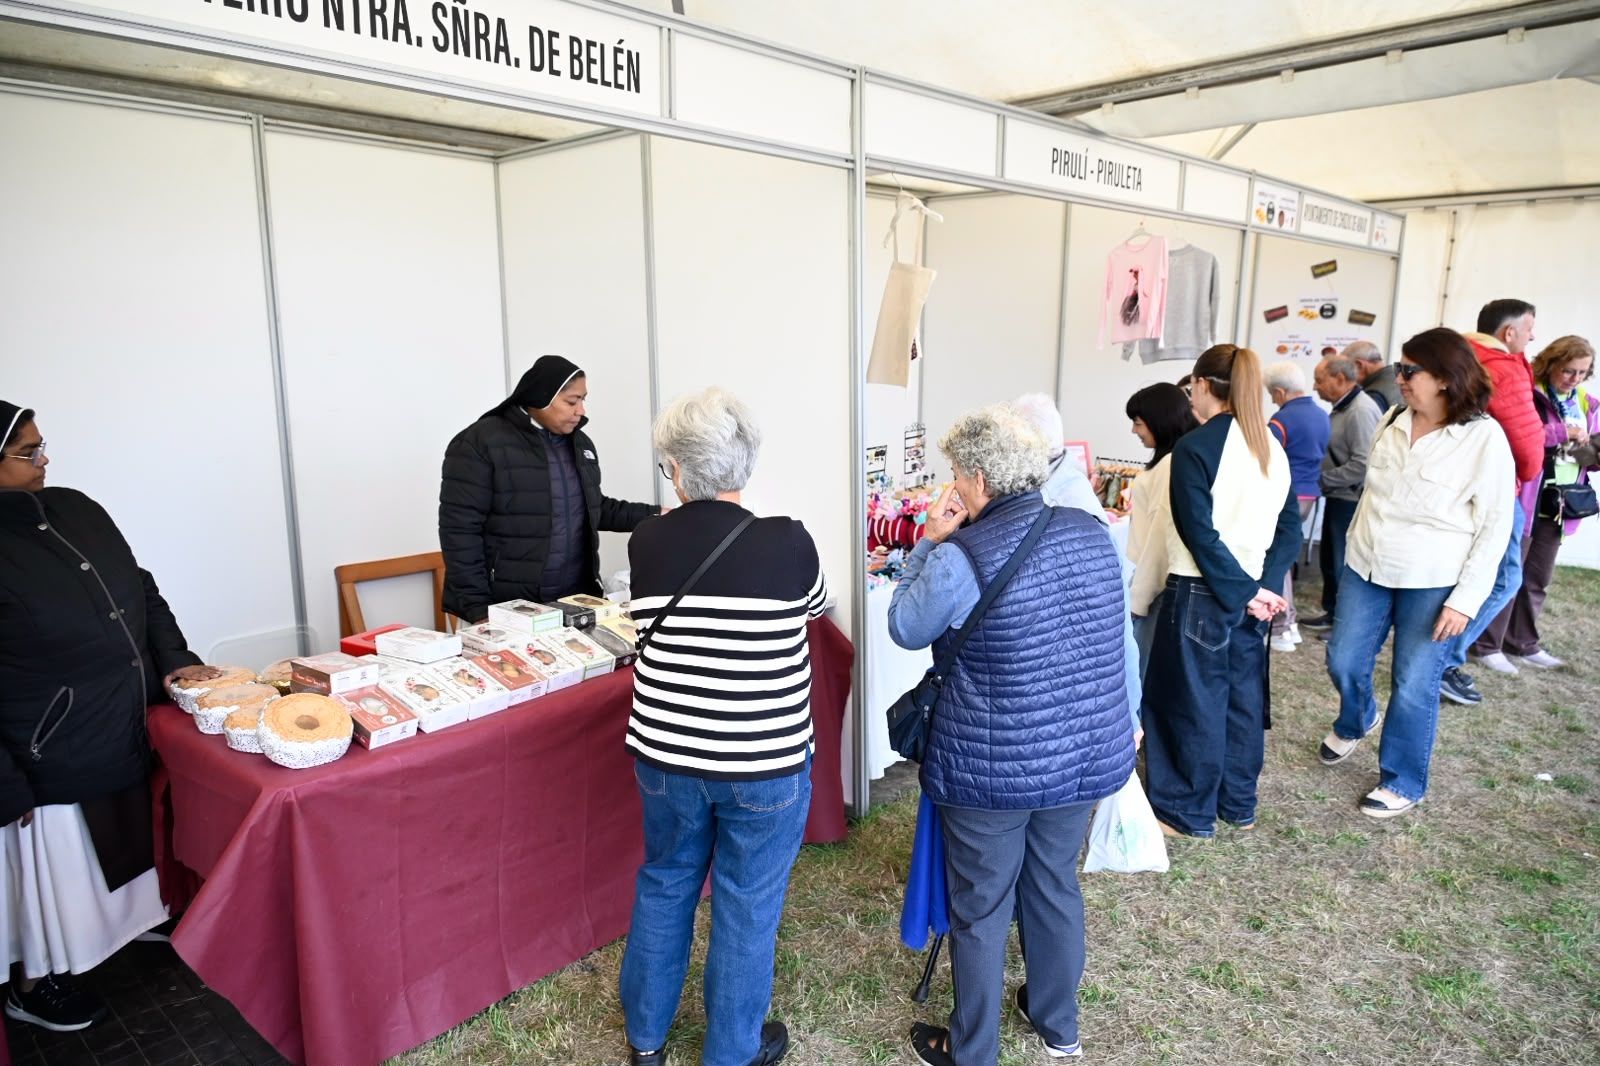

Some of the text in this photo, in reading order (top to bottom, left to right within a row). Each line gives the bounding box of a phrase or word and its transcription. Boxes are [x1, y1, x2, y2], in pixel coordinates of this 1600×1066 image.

[431, 0, 520, 69] SÑRA.
[528, 25, 561, 77] DE
[569, 35, 641, 94] BELÉN
[1051, 147, 1089, 180] PIRULÍ
[1096, 158, 1143, 192] PIRULETA
